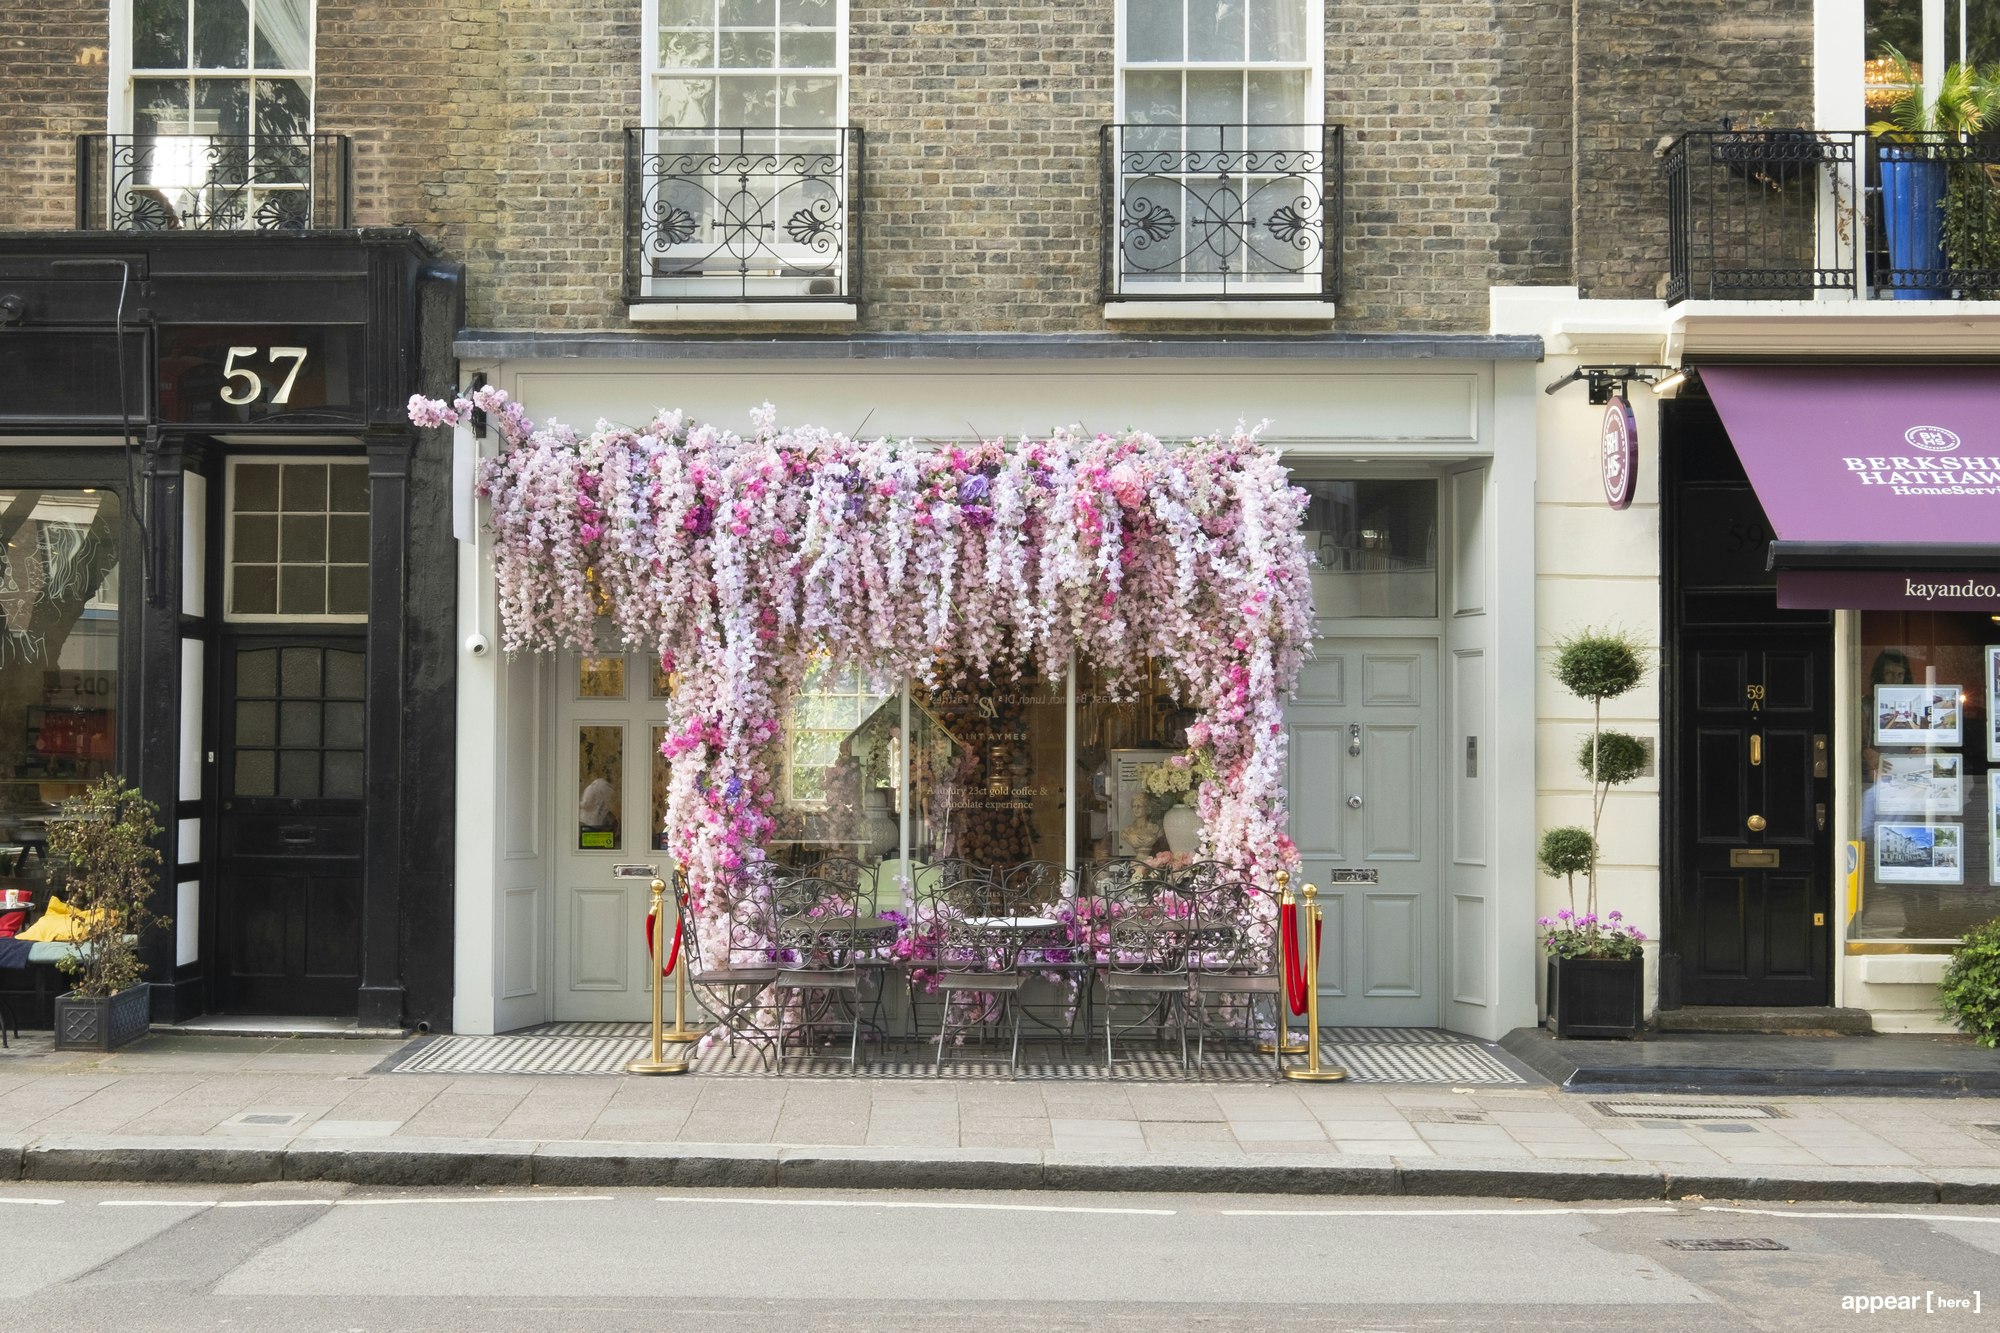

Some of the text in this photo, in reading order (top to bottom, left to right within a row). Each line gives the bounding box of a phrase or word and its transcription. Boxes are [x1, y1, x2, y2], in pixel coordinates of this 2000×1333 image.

[220, 346, 308, 405] 57
[1919, 432, 1943, 440] BH
[1923, 438, 1946, 446] HS
[1727, 523, 1764, 553] 59
[1747, 684, 1765, 700] 59
[1751, 700, 1760, 711] A
[952, 733, 1027, 741] AINT AYMES
[968, 787, 987, 795] 23ct
[989, 786, 1009, 798] gold
[1011, 786, 1037, 796] coffee
[1039, 787, 1048, 795] &
[985, 800, 1033, 811] experience
